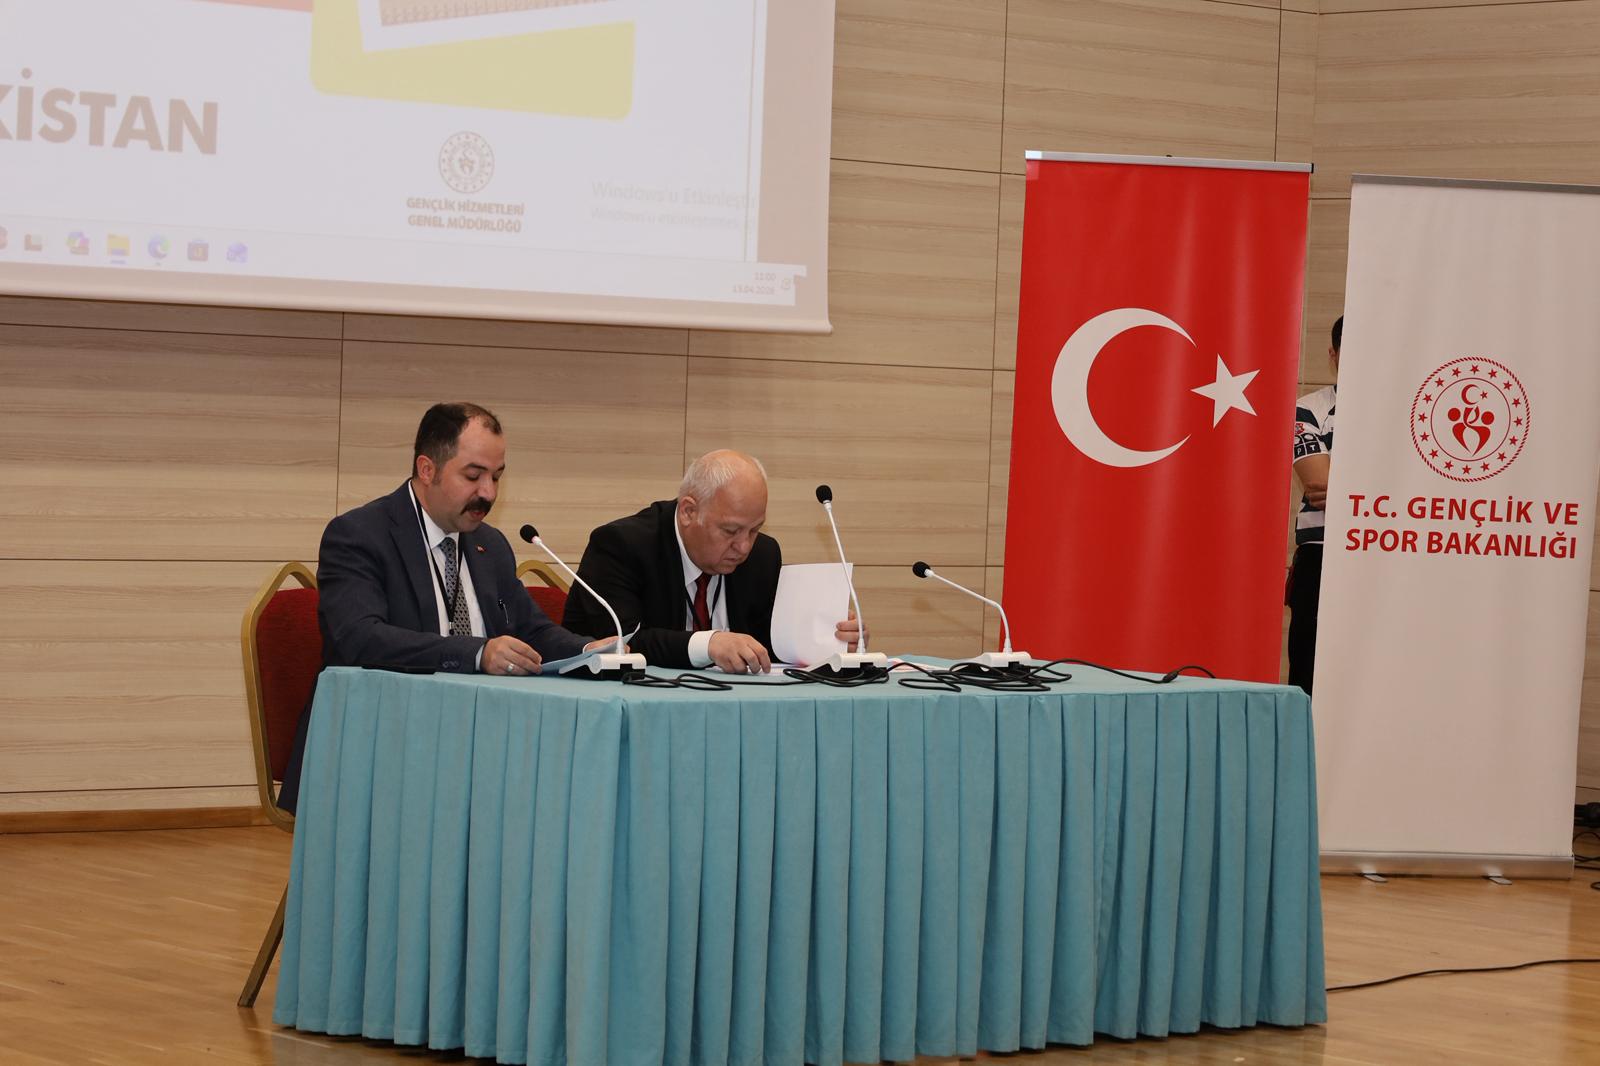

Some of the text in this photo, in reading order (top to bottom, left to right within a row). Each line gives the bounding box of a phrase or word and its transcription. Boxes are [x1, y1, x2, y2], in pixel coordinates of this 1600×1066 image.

[406, 197, 525, 216] GENÇLİK HİZMETLERİ
[408, 214, 522, 233] GENEL MÜDÜRLÜĞÜ
[1349, 494, 1579, 528] T.C. GENÇLİK VE
[1345, 528, 1577, 559] SPOR BAKANLIĞI
